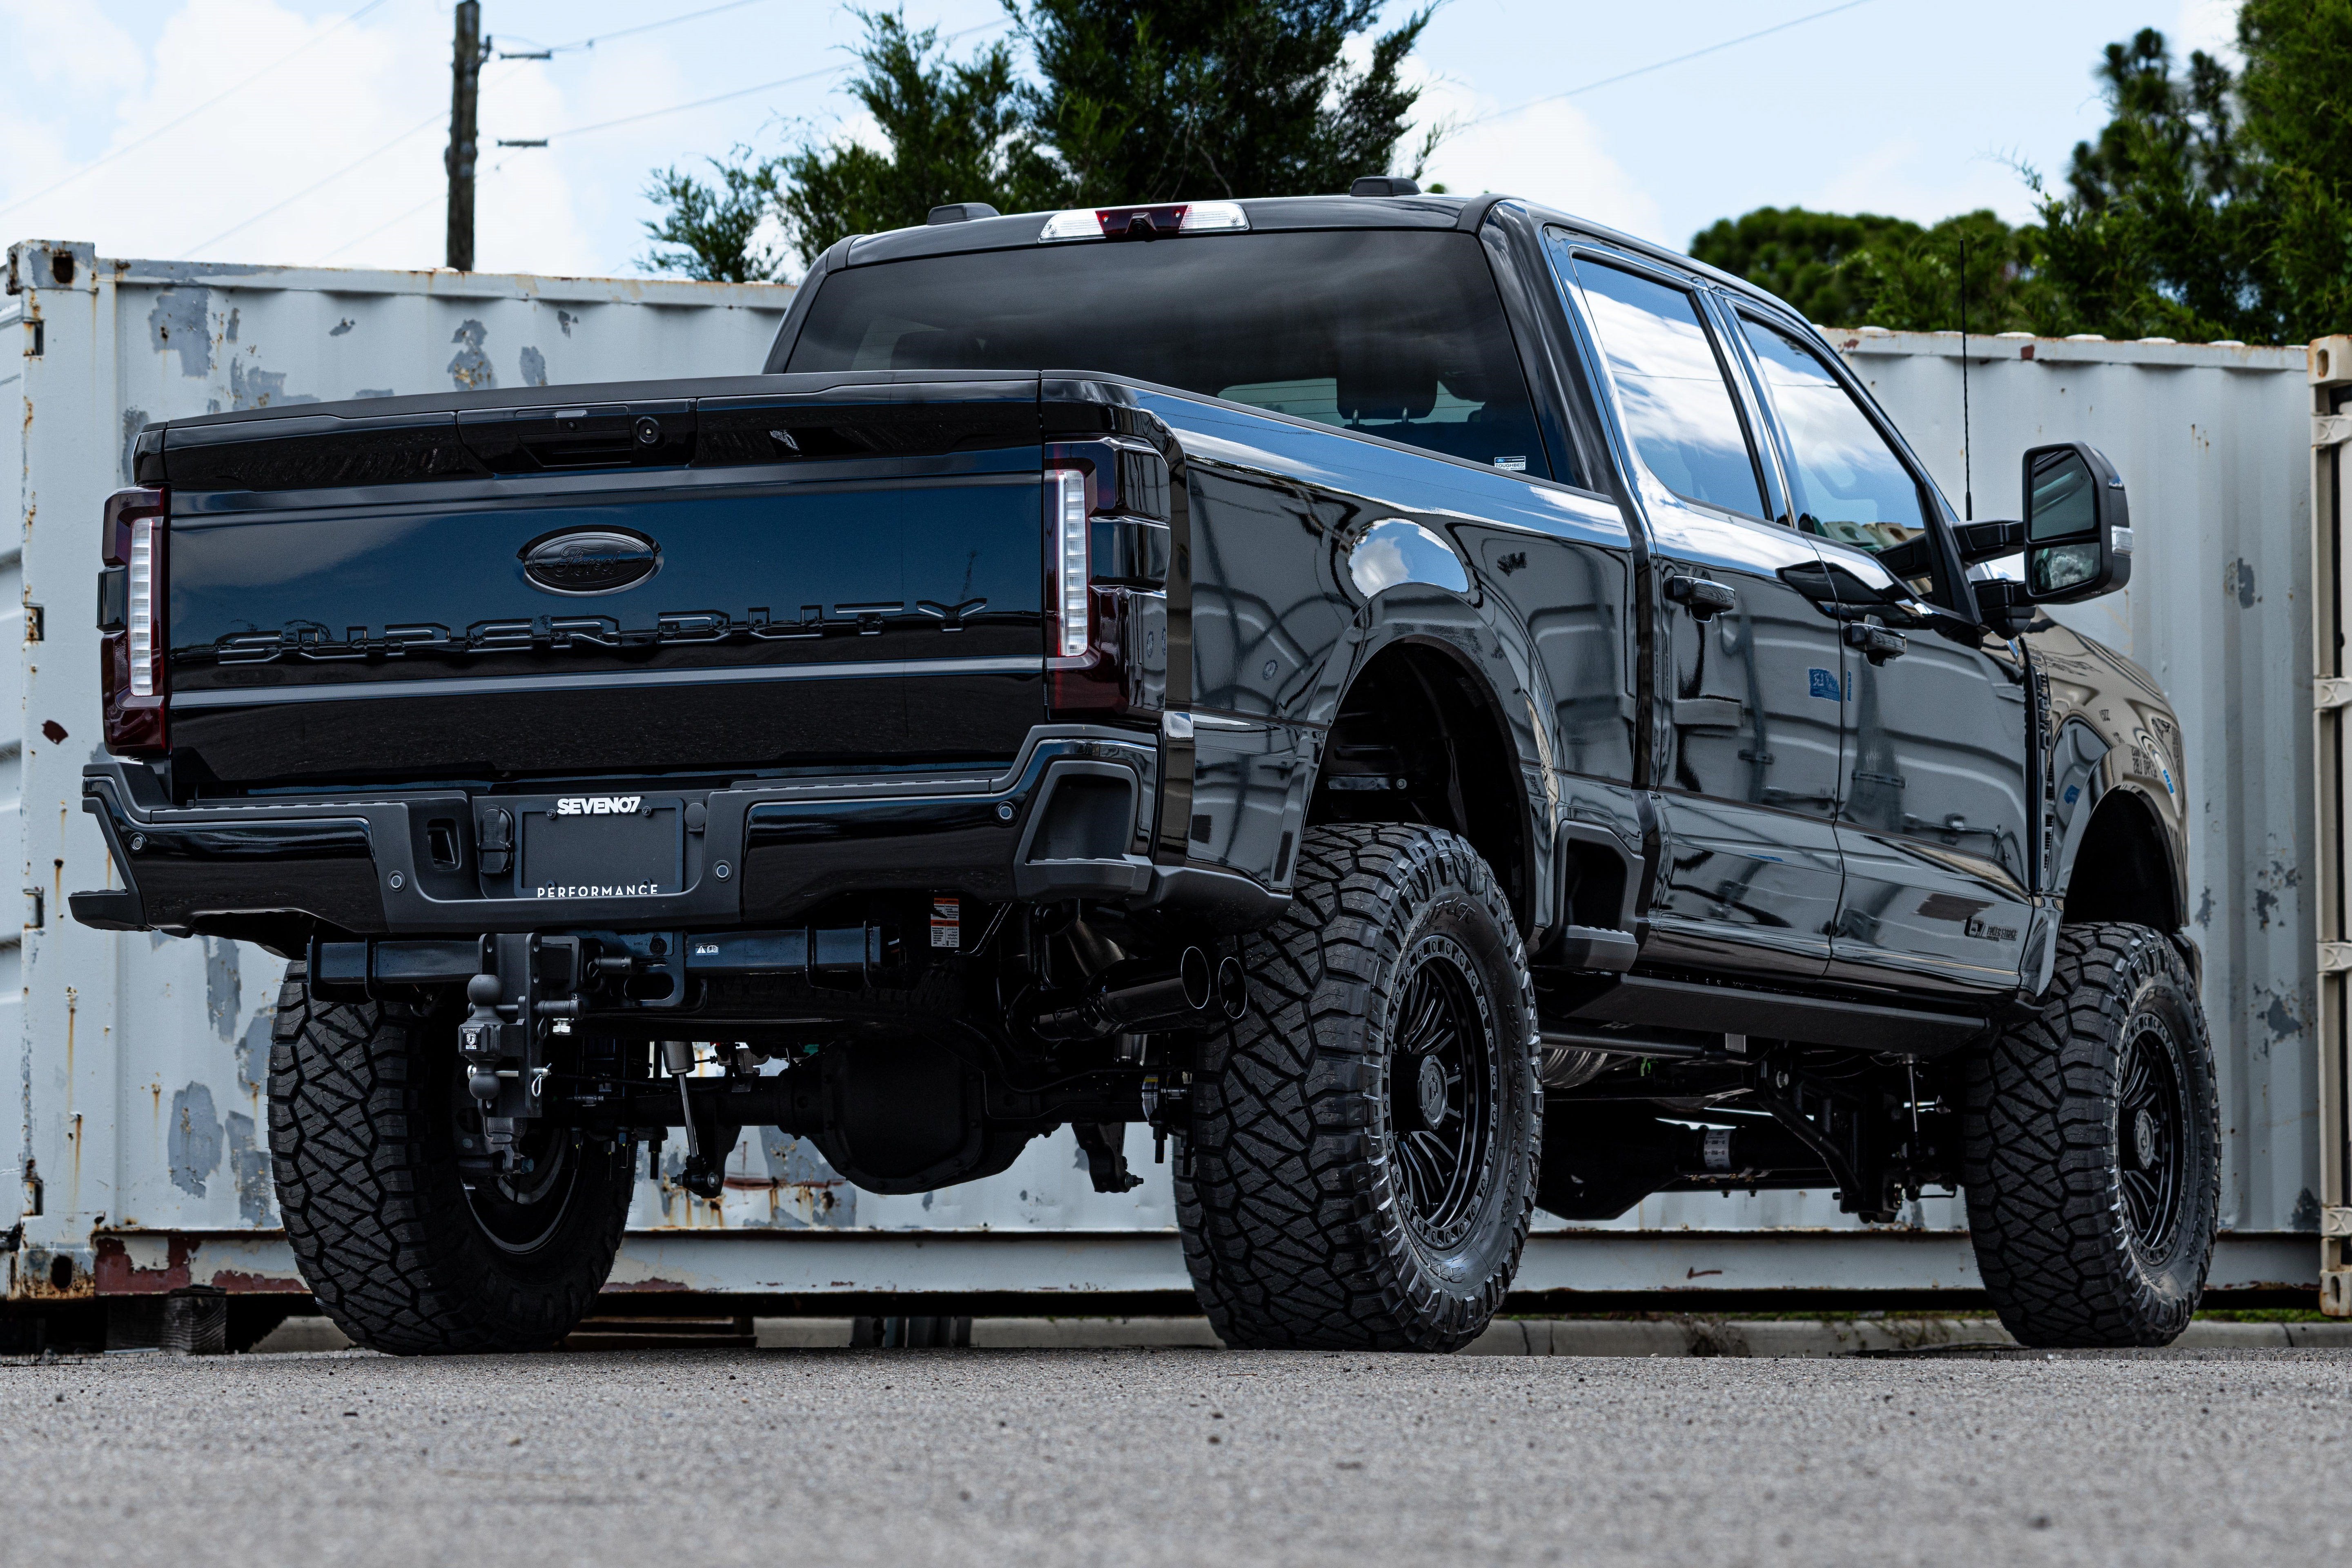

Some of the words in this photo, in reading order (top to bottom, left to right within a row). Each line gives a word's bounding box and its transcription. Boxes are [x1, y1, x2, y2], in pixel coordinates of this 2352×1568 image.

[554, 543, 621, 577] Ford
[215, 615, 620, 665] SUPER
[658, 597, 987, 644] DUTY
[537, 884, 658, 898] PERFORMANCE
